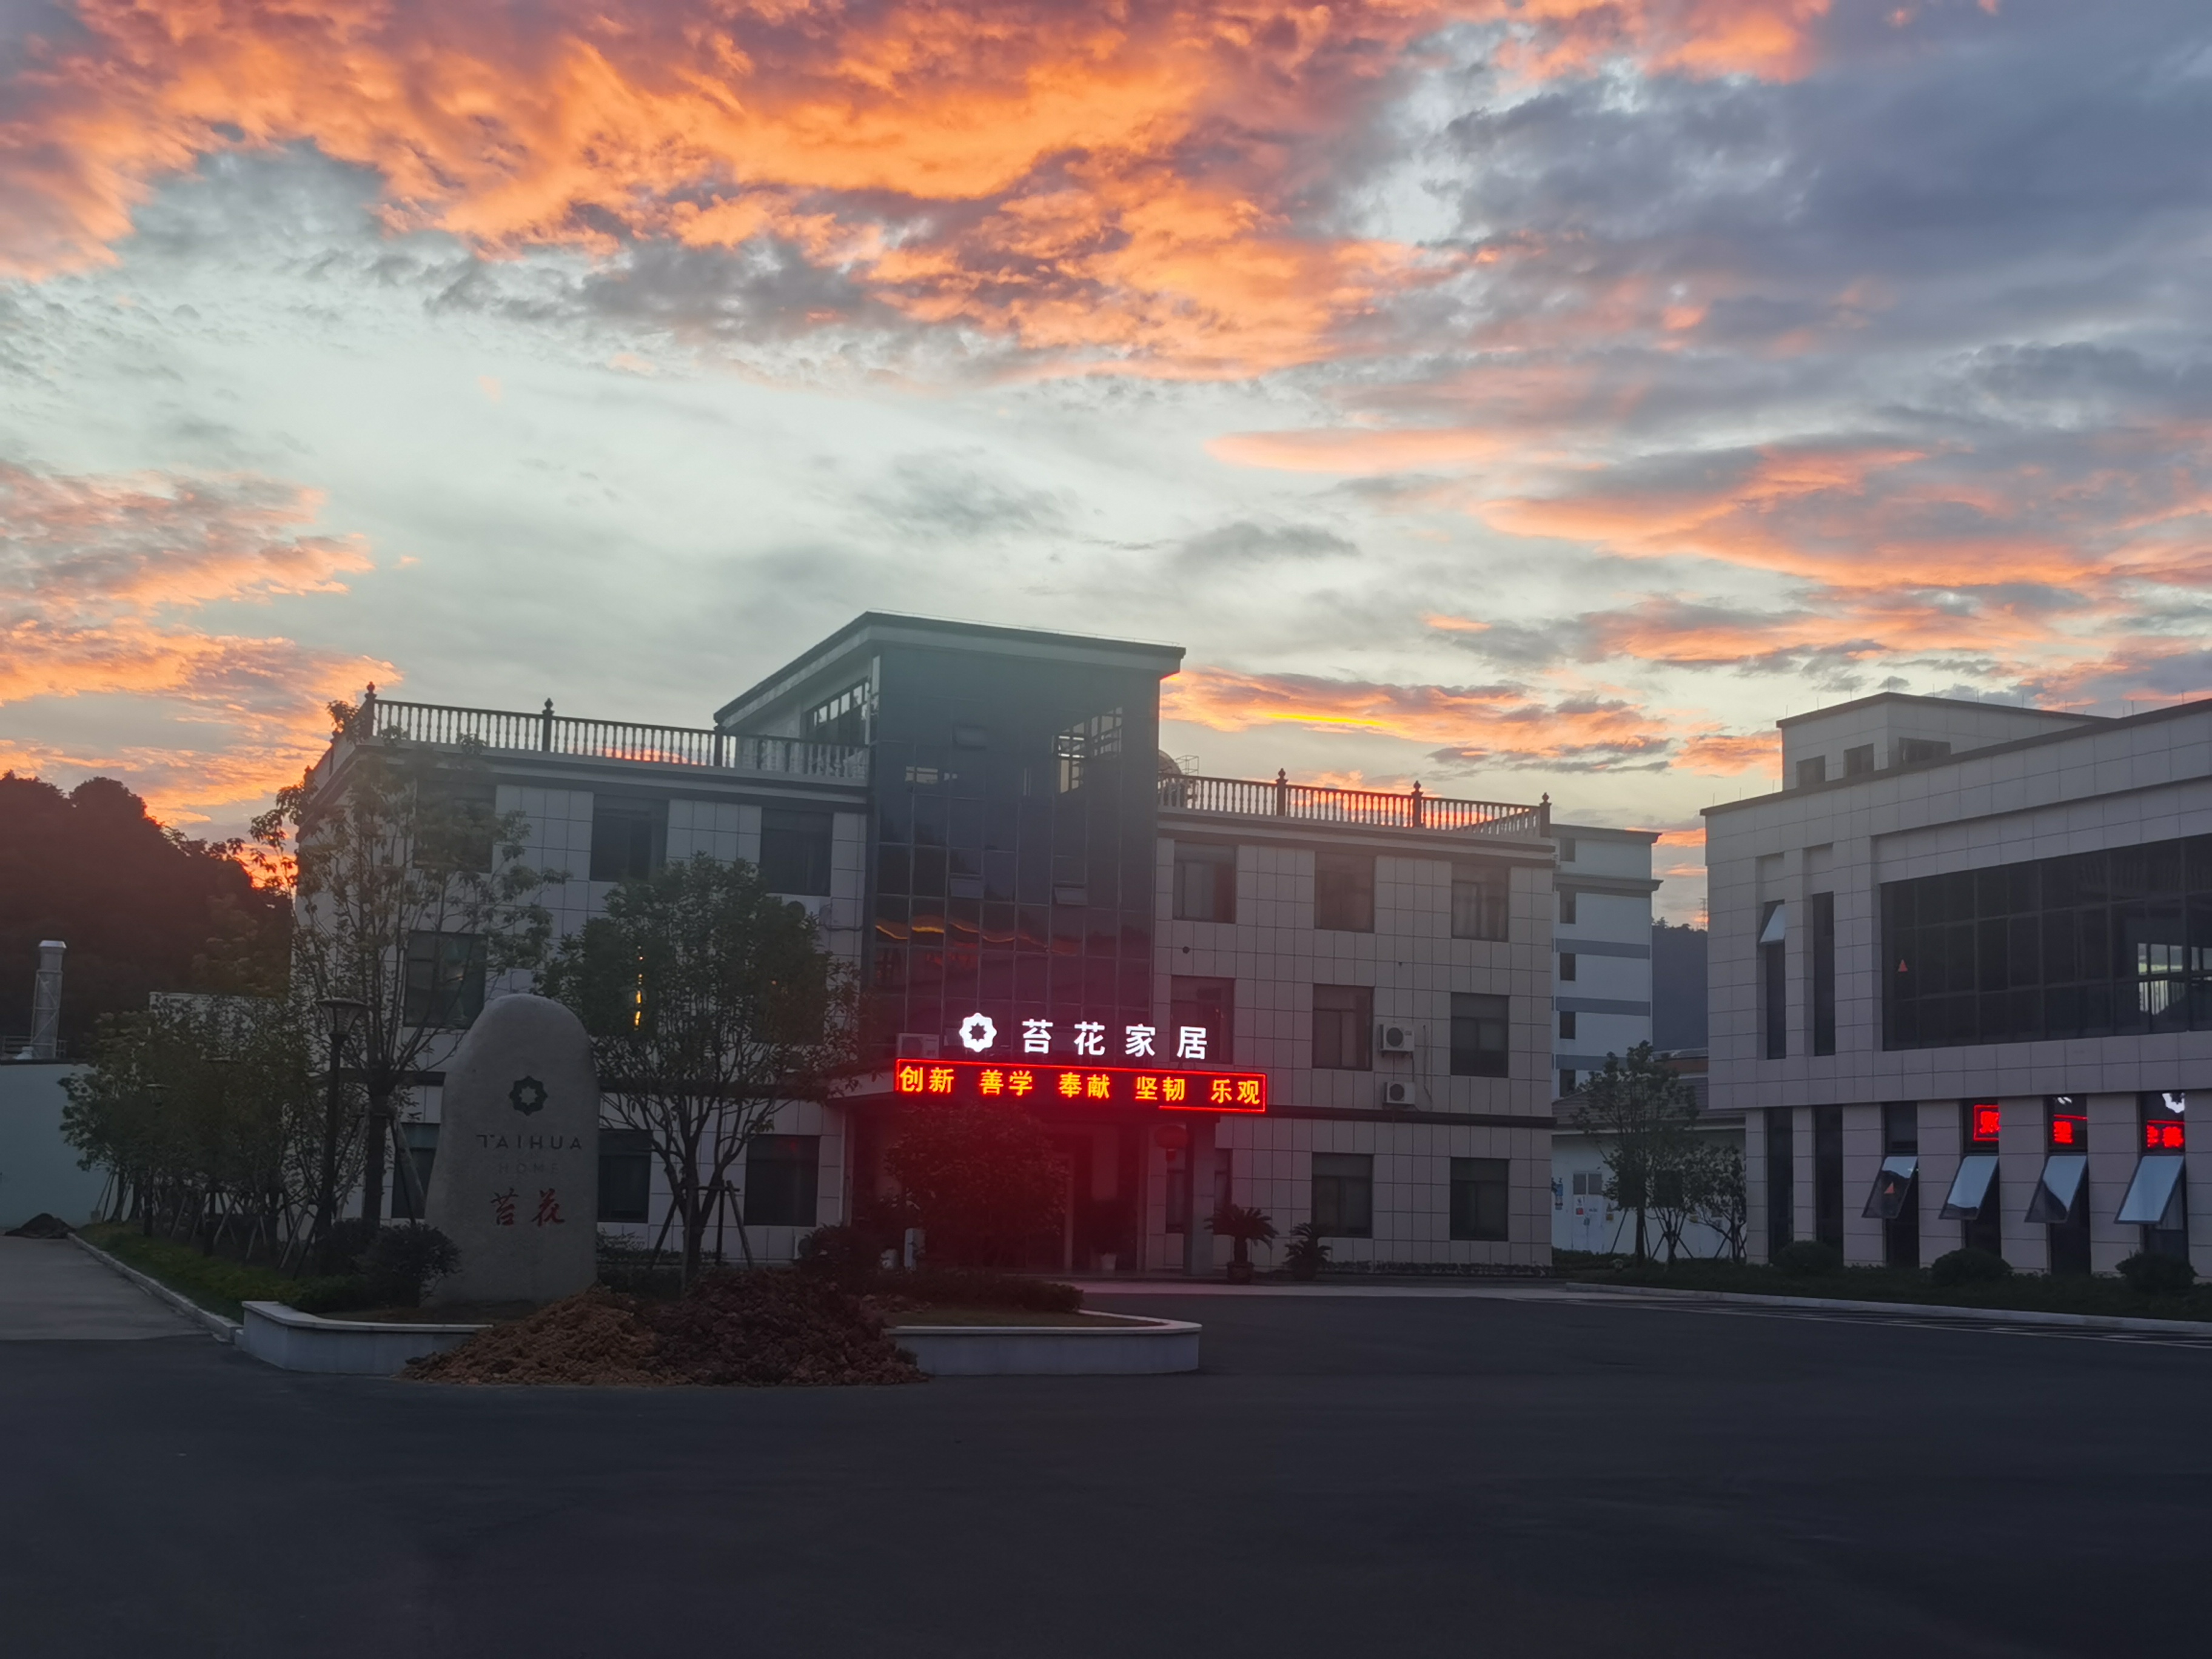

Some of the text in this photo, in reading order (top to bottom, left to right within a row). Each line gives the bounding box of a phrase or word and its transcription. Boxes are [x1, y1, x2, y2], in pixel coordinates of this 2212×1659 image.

[1022, 1019, 1208, 1059] 苔花家居
[899, 1065, 1261, 1105] 创新 善学 奉献 坚韧 乐观
[476, 1134, 582, 1150] TAIHUA
[490, 1187, 566, 1227] 苔花
